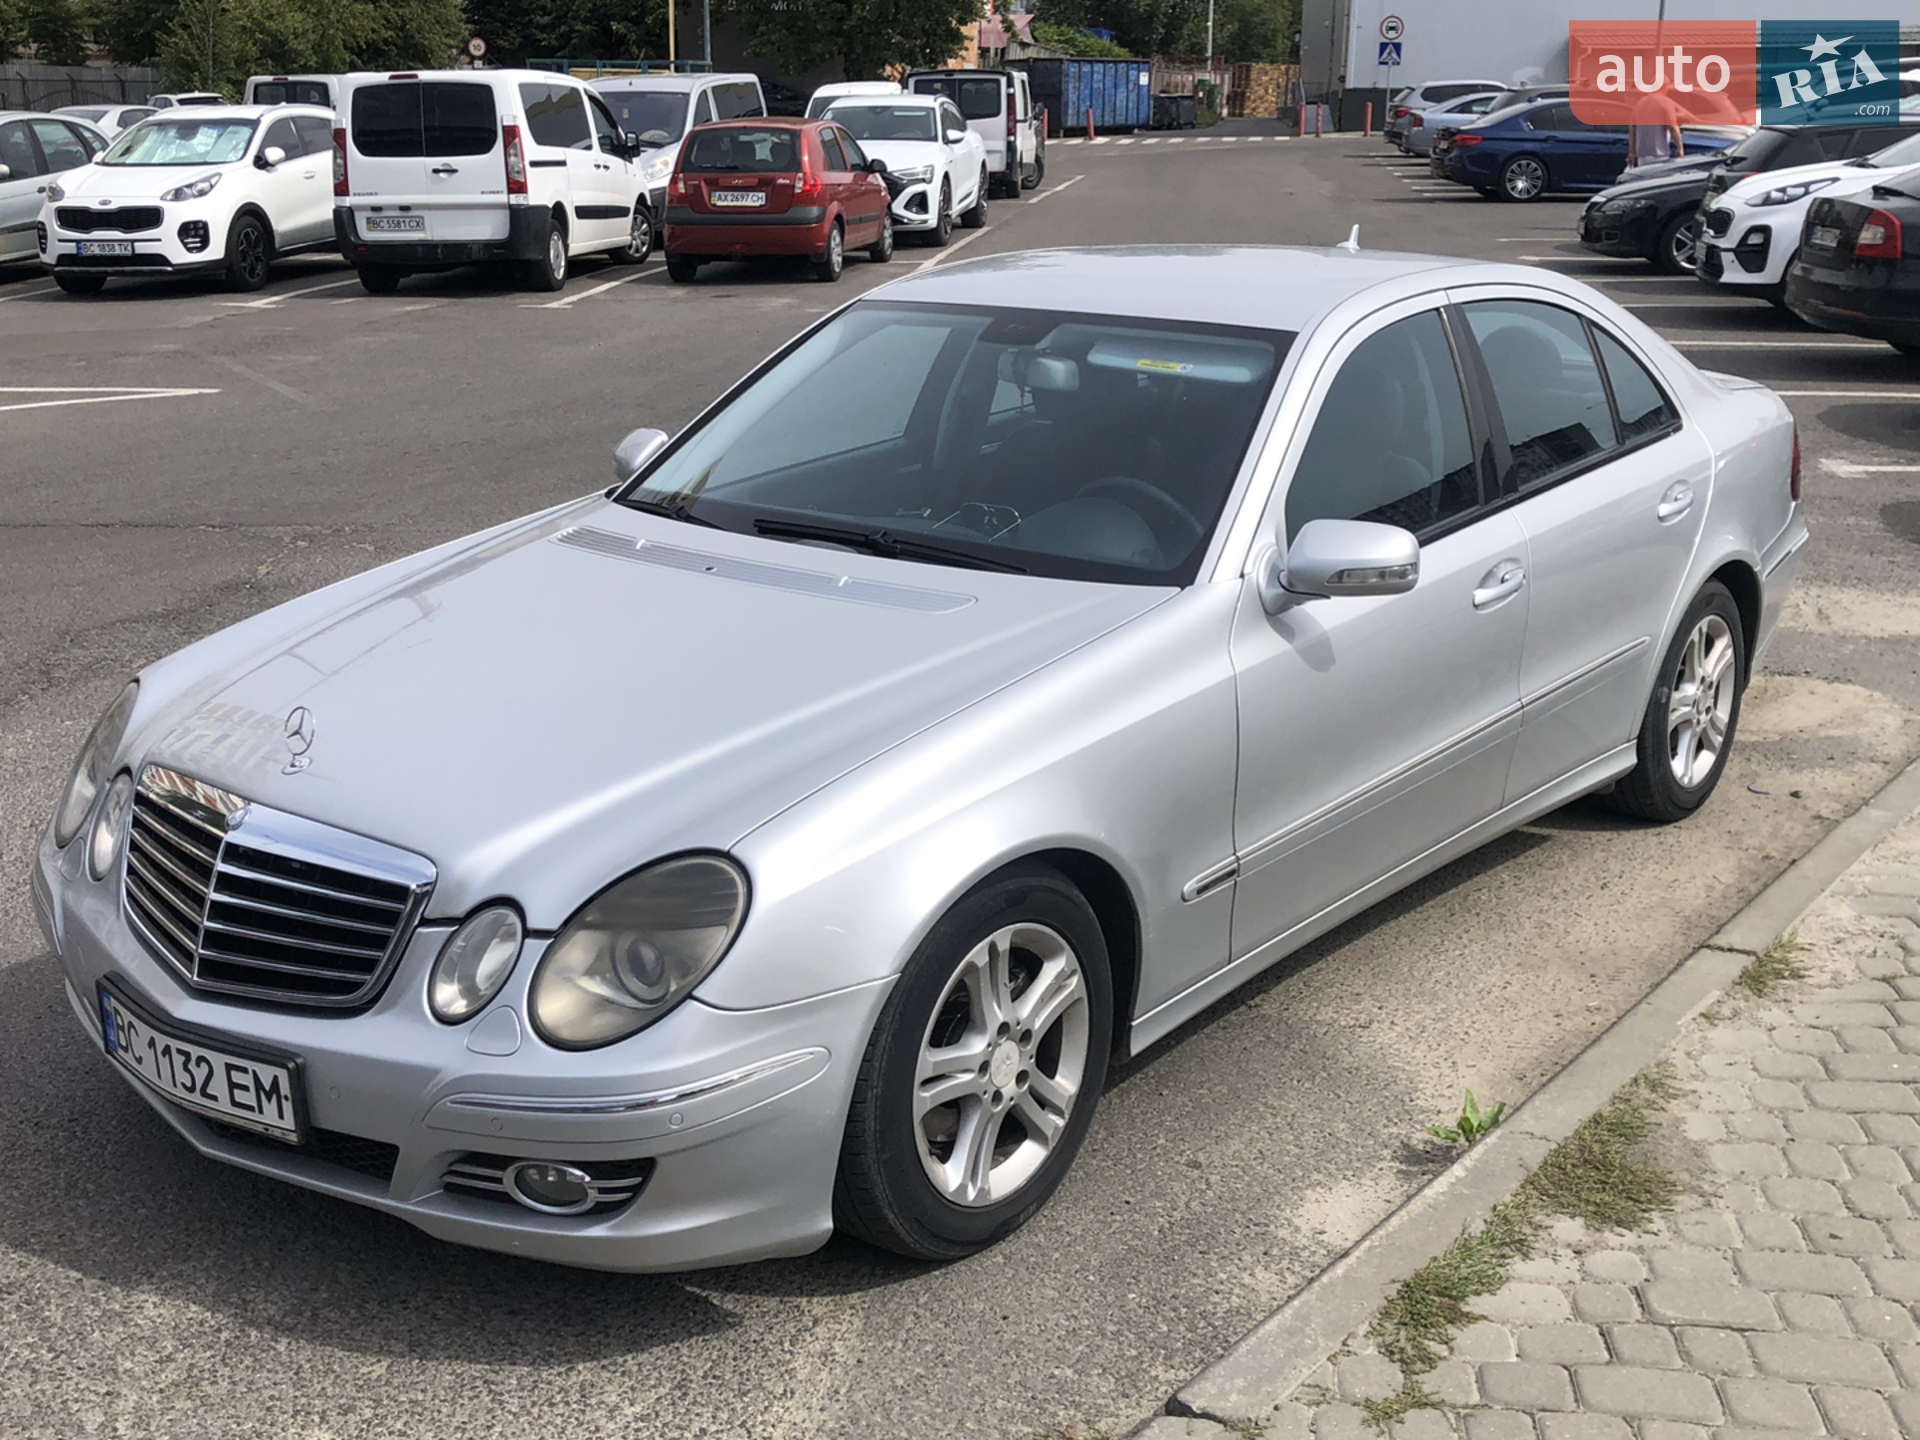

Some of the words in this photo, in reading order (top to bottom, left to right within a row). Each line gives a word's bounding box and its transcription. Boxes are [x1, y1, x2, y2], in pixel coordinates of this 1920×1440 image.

[717, 193, 729, 202] AX
[731, 193, 749, 202] 2697
[751, 193, 764, 202] CH
[372, 217, 385, 229] BC
[387, 217, 407, 229] 5581
[409, 217, 422, 229] CX
[83, 243, 95, 253] BC
[117, 243, 131, 253] TK
[113, 1005, 143, 1066] BC
[147, 1035, 220, 1103] 1132
[224, 1061, 285, 1121] EM
